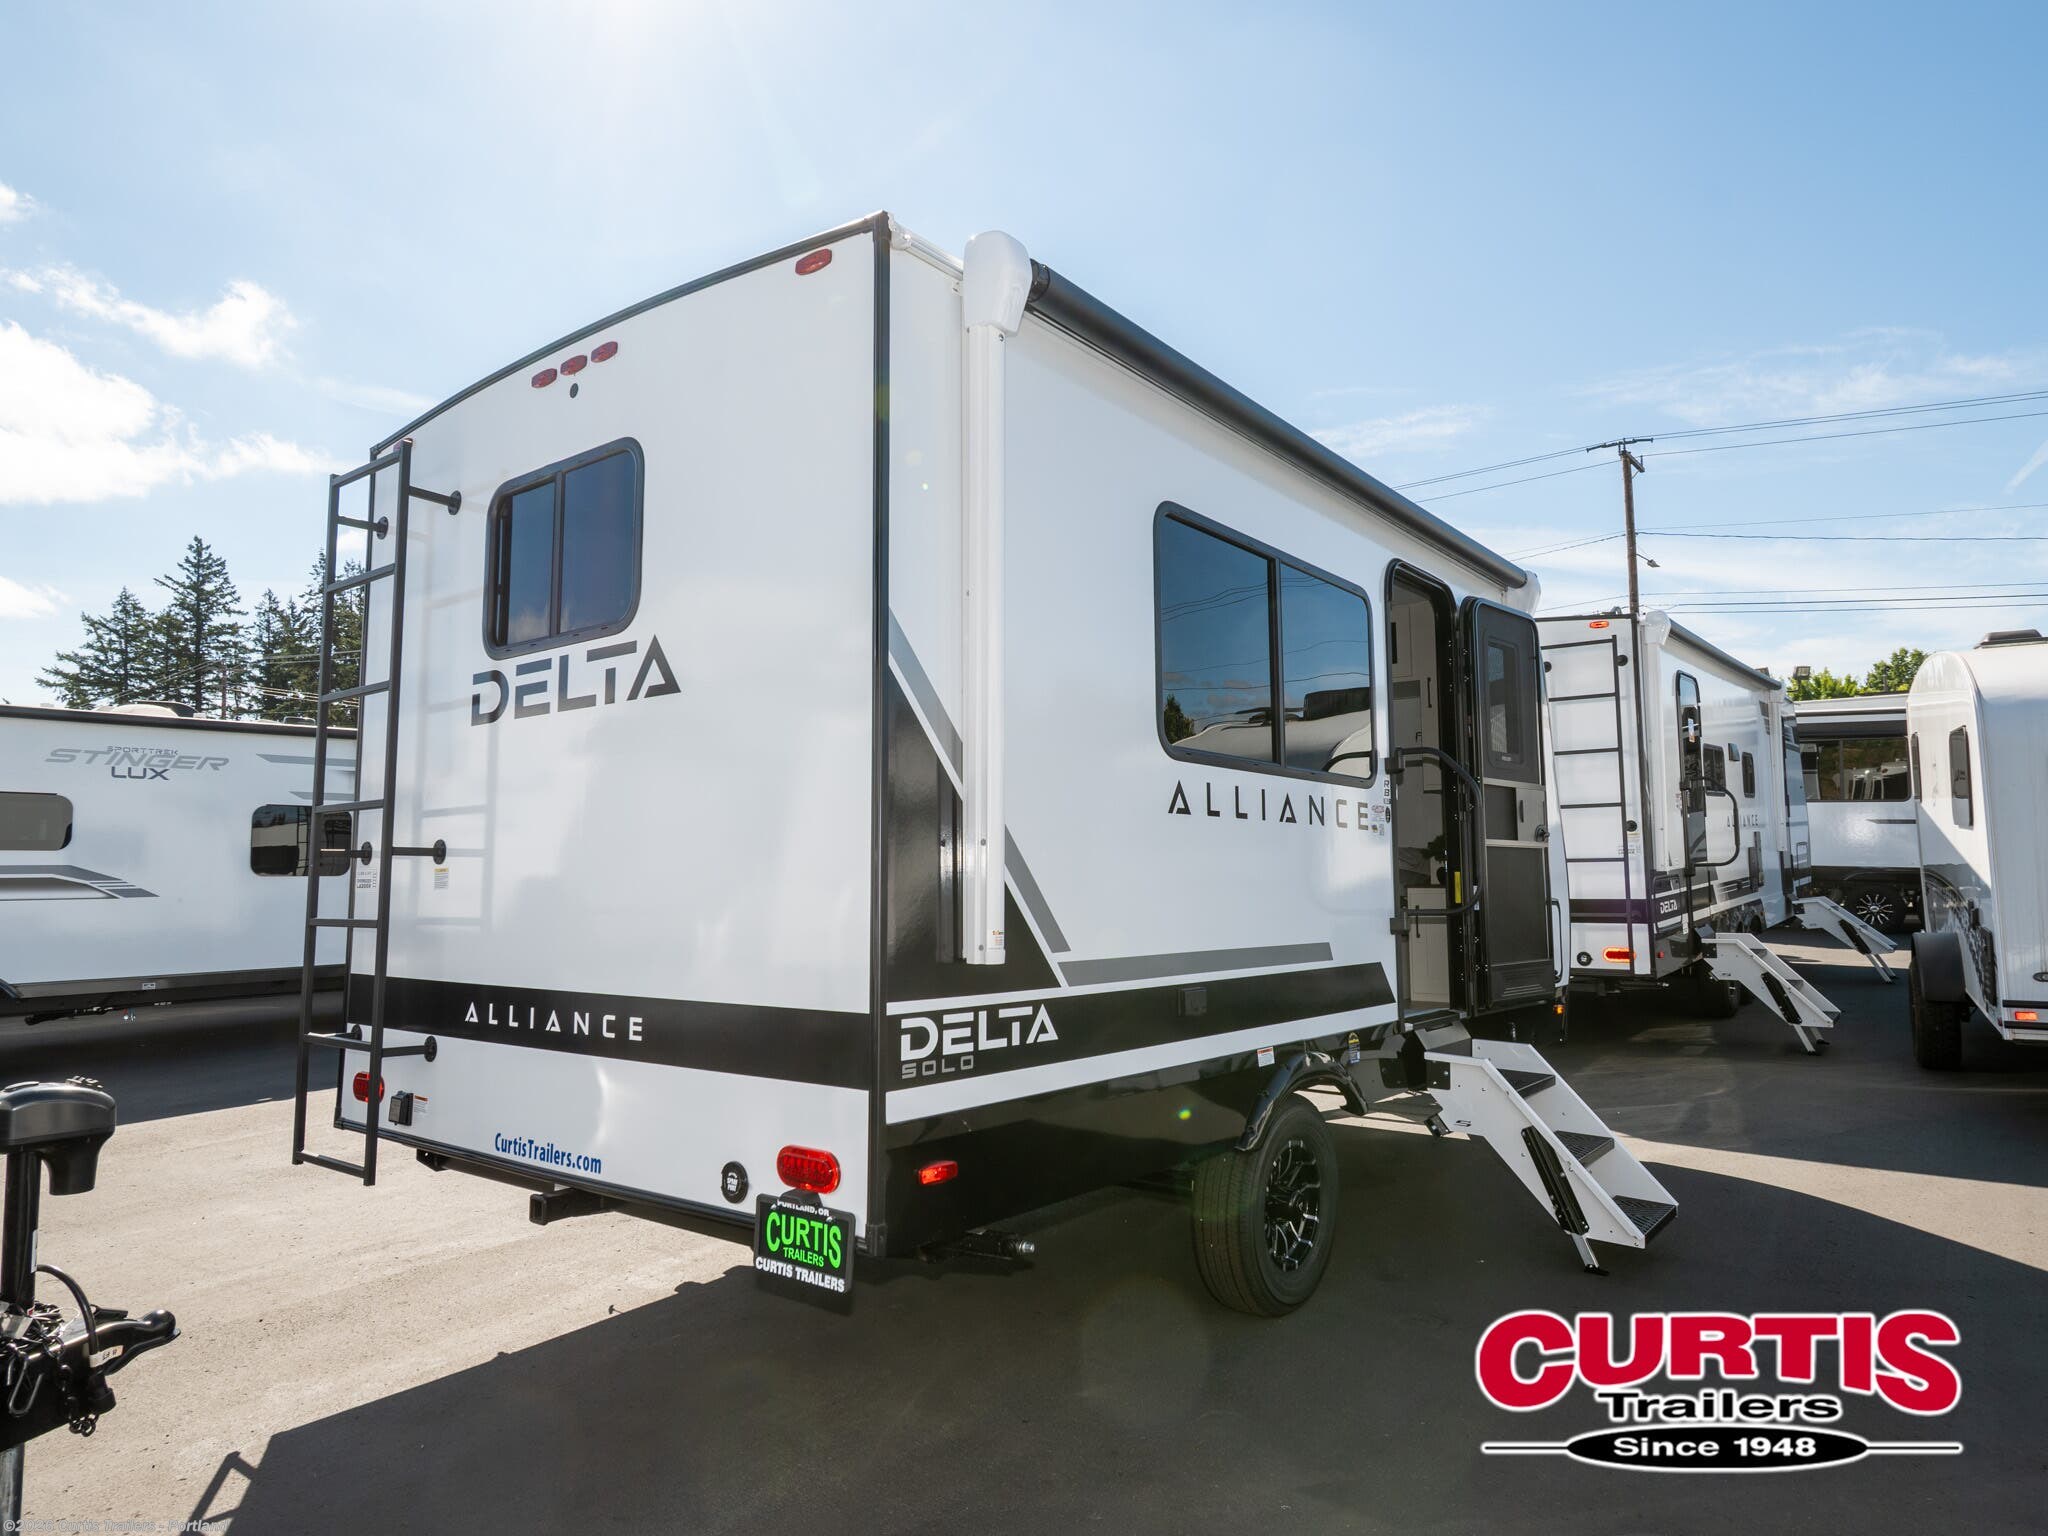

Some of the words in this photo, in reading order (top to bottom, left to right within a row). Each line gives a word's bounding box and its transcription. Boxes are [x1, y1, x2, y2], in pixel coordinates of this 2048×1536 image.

[471, 634, 682, 727] DELTA
[44, 748, 230, 771] STINGER
[111, 766, 171, 781] LUX
[1168, 780, 1369, 831] ALLIANCE
[1659, 899, 1678, 914] DELTA
[464, 1001, 643, 1041] ALLIANCE
[900, 1003, 1059, 1061] DELTA
[901, 1055, 975, 1080] SOLO
[495, 1132, 602, 1175] CurtisTrailers.com
[766, 1211, 842, 1269] CURTIS
[783, 1247, 825, 1268] TRAILERS
[755, 1256, 793, 1278] CURTIS
[795, 1267, 845, 1293] TRAILERS
